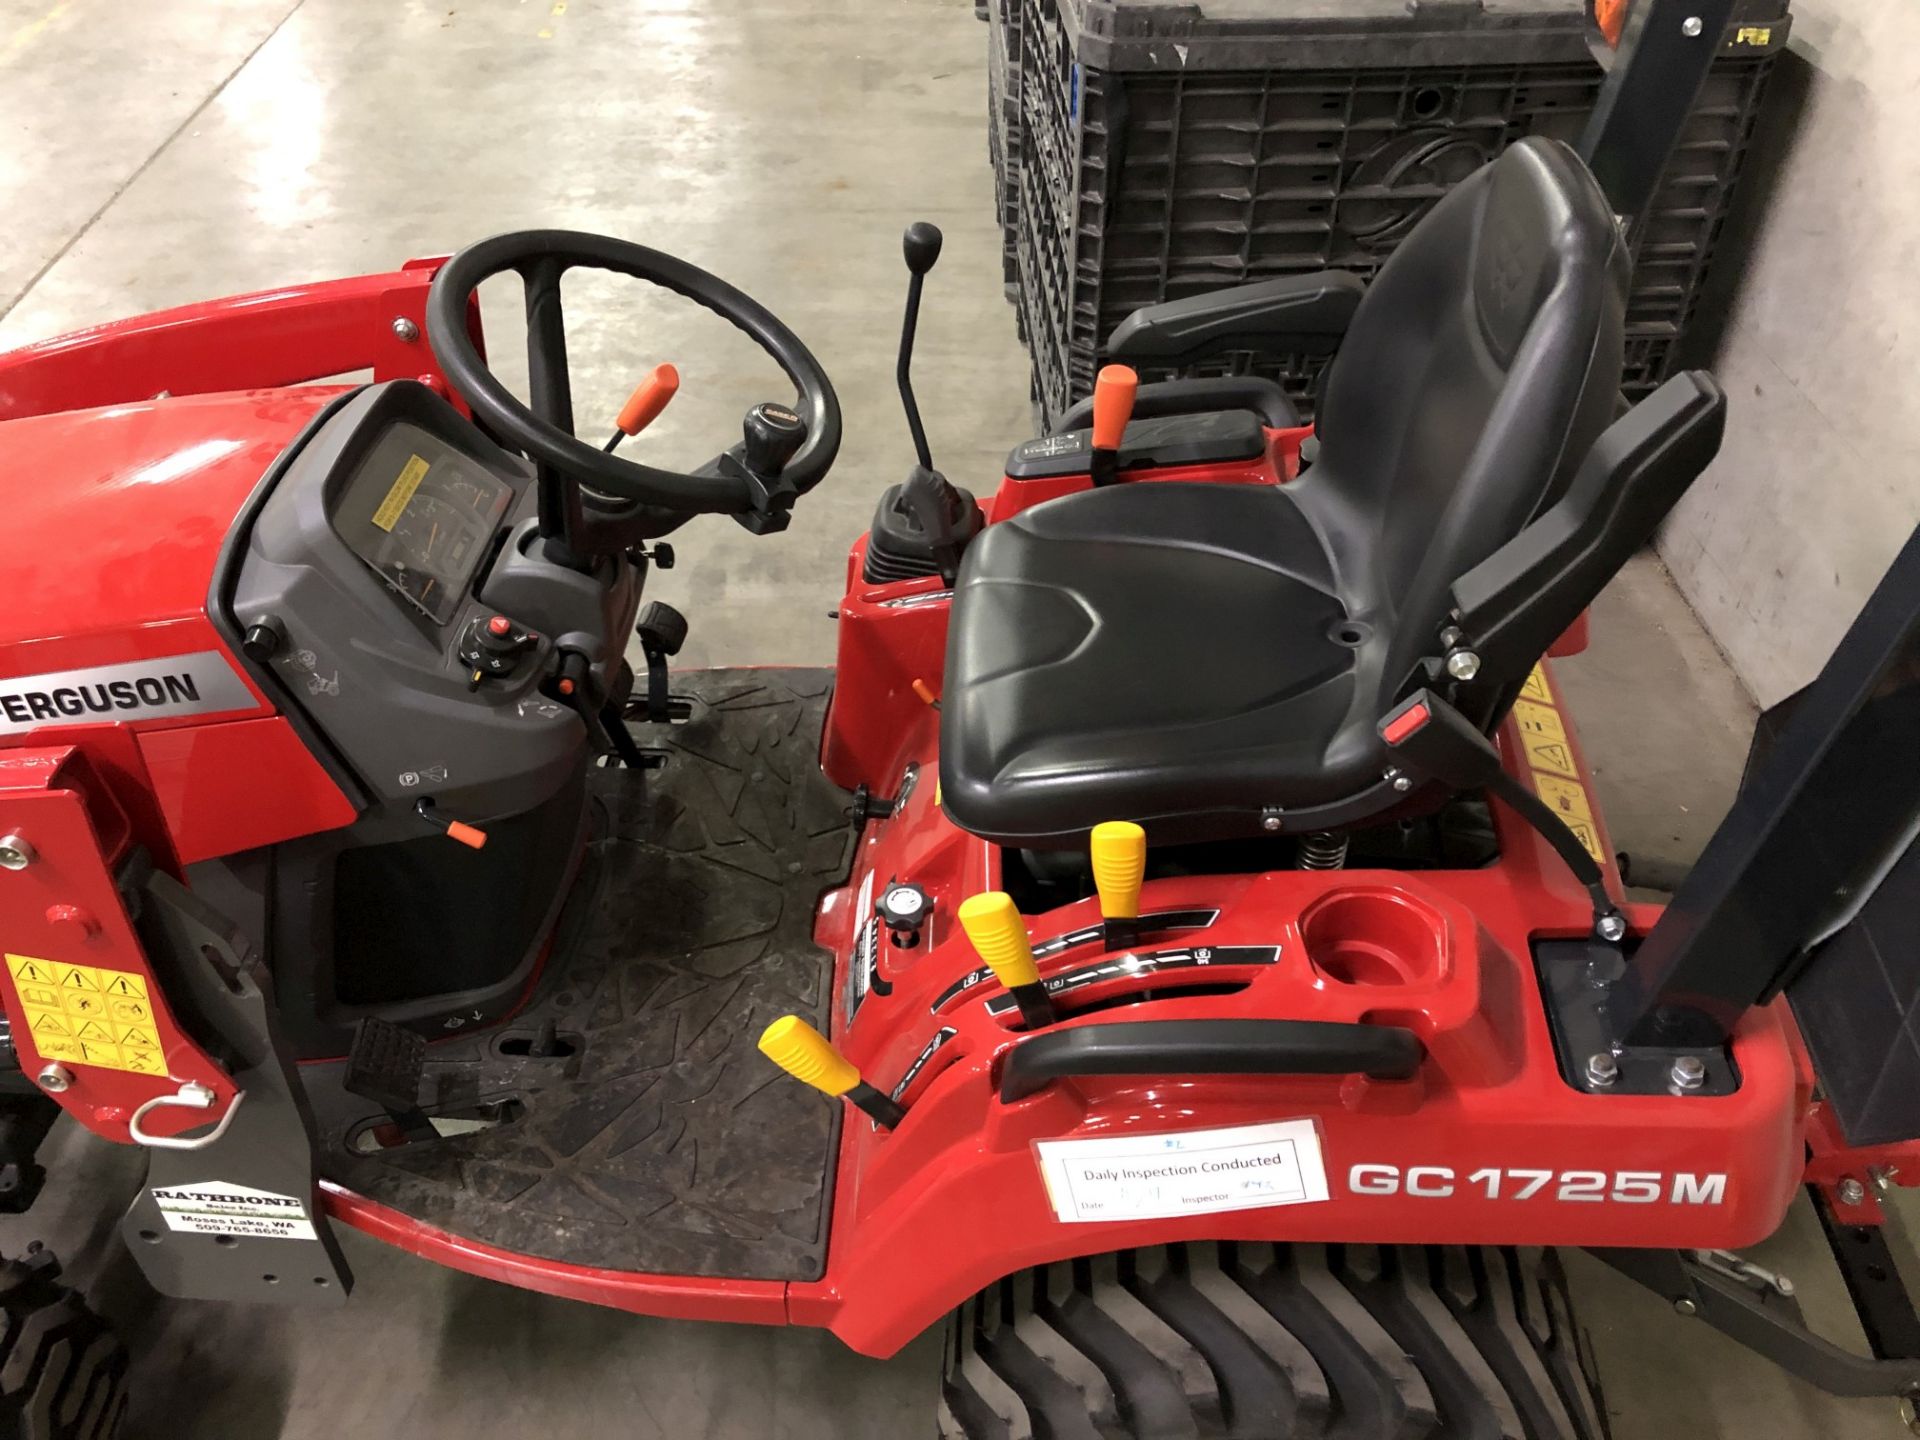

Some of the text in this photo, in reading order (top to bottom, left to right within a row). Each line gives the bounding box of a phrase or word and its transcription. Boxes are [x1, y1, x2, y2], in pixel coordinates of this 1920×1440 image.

[0, 673, 200, 722] ERGUSON
[1084, 1153, 1282, 1182] Daily Inspection Conducted
[153, 1190, 301, 1207] RATHBONE
[1081, 1200, 1104, 1210] Date
[1182, 1192, 1230, 1206] Inspector
[181, 1215, 295, 1229] Moses Lake, WA
